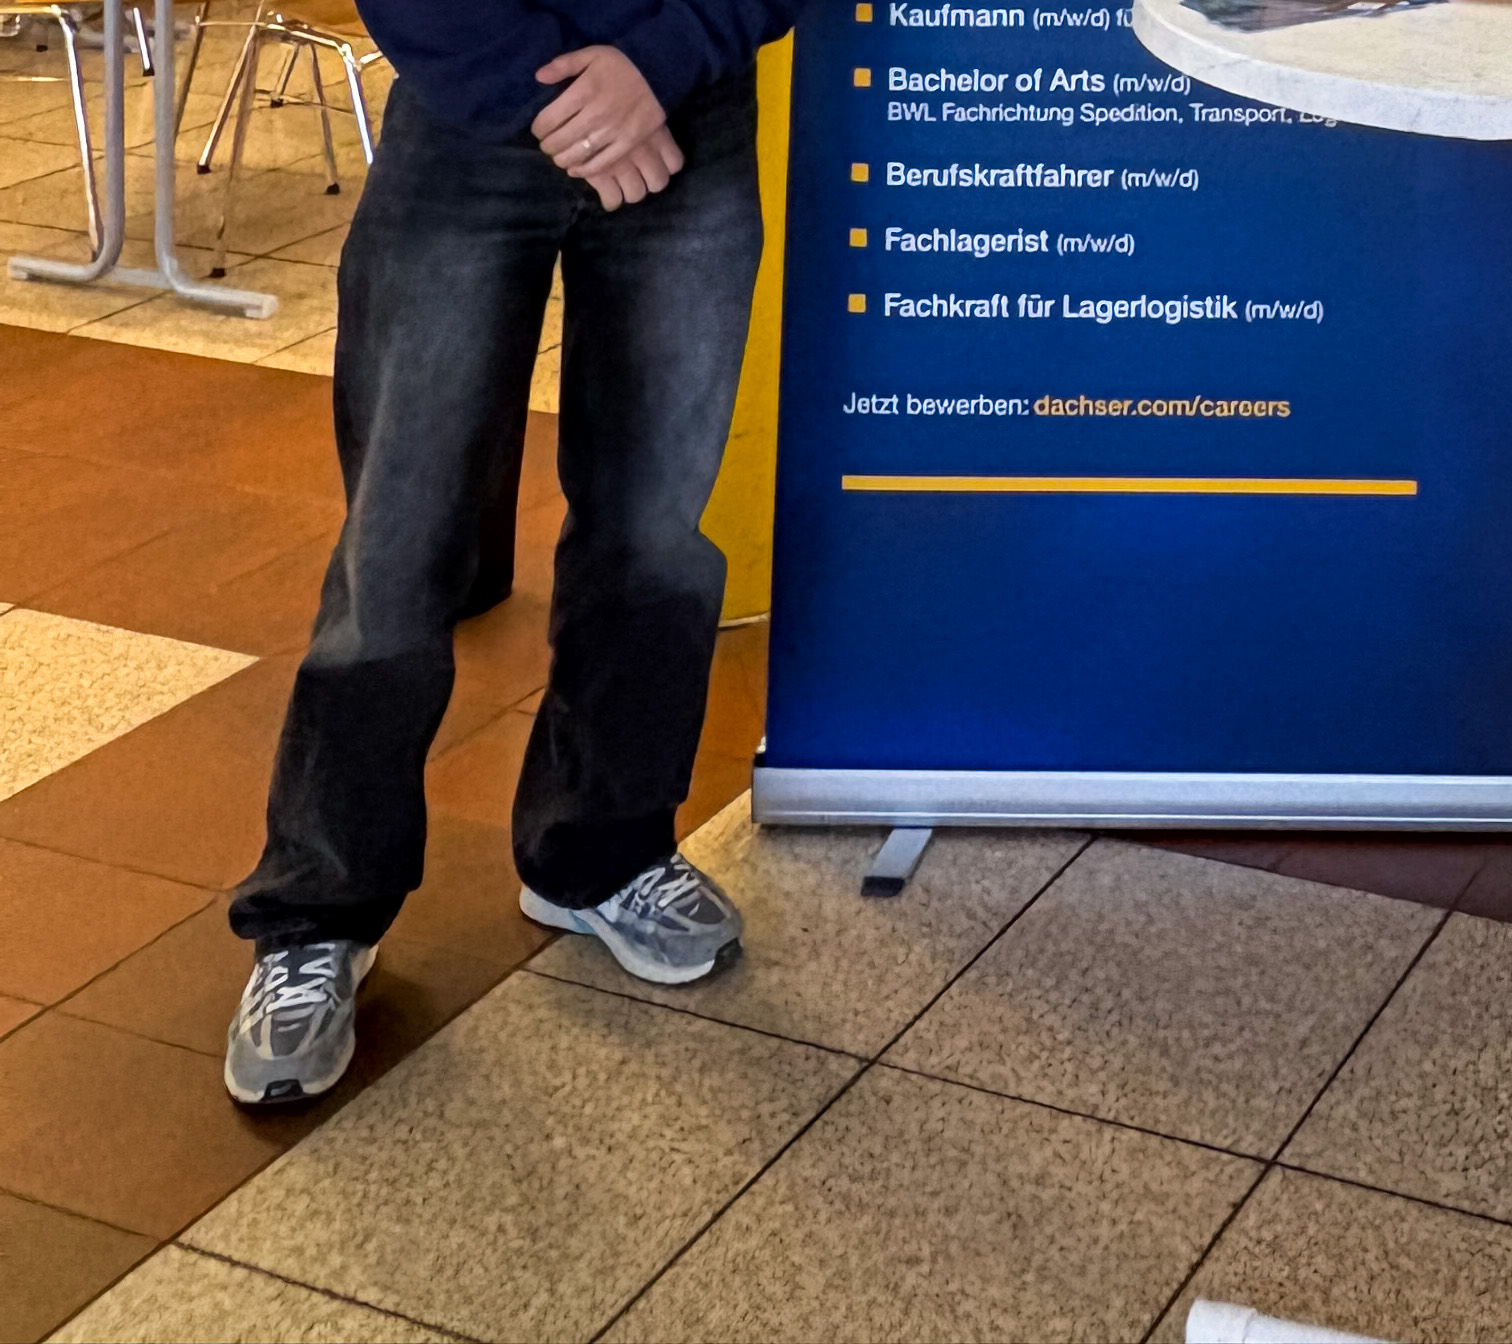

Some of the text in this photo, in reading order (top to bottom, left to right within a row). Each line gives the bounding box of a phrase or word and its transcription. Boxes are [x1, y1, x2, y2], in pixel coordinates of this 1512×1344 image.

[889, 2, 1134, 31] Kaufmann (m/w/d) fü
[888, 66, 1191, 96] Bachelor of Arts (m/w/d)
[887, 101, 937, 122] BWL
[942, 102, 1075, 127] Fachrichtung
[1079, 102, 1184, 127] Spedition,
[886, 161, 1199, 192] Berufskraftfahrer (m/w/d)
[884, 227, 1135, 258] Fachlagerist (m/w/d)
[883, 292, 1324, 324] Fachkraft für Lagerlogistik (m/w/d)
[843, 392, 1291, 418] Jetzt bewerben: dachser.com/careers
